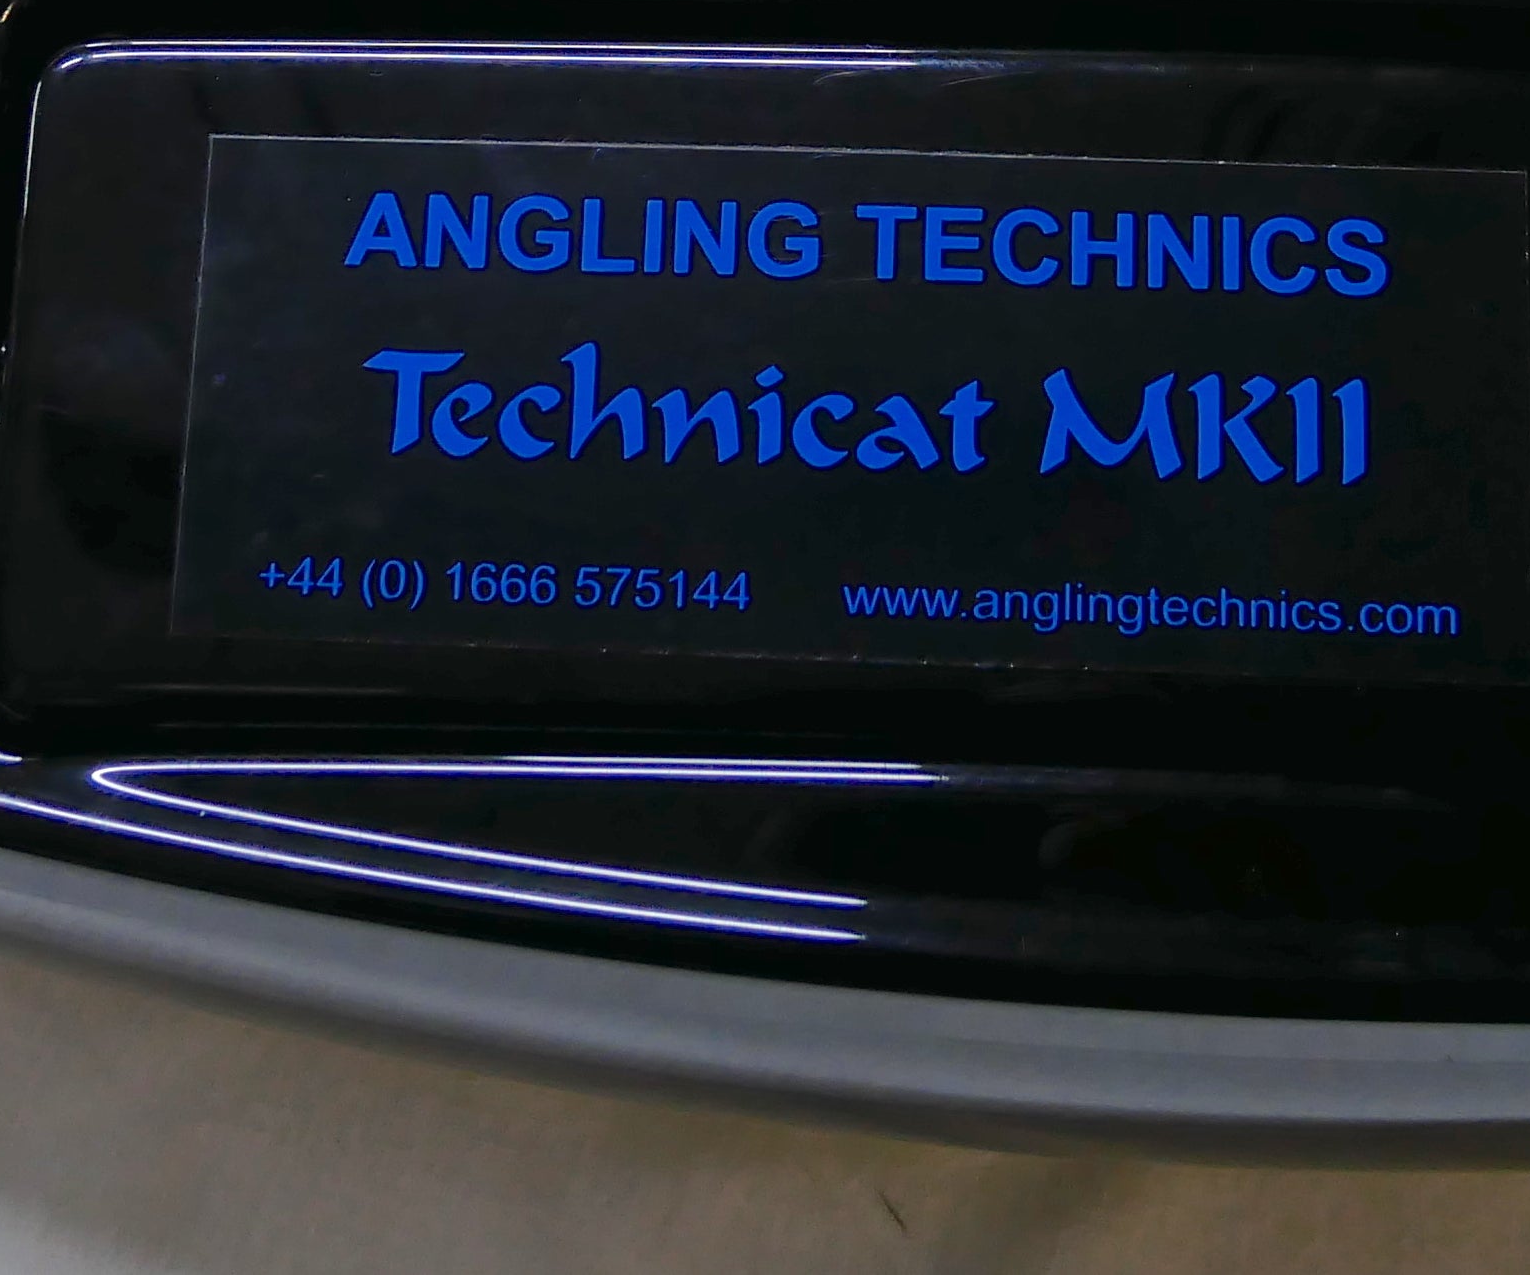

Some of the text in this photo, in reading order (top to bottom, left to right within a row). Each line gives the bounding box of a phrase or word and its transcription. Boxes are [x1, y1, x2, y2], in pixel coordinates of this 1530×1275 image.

[342, 191, 1389, 297] ANGLING TECHNICS
[362, 341, 995, 472] Technicat
[259, 556, 750, 610] +44 (0) 1666 575144
[842, 582, 1459, 636] www.anglingtechnics.com
